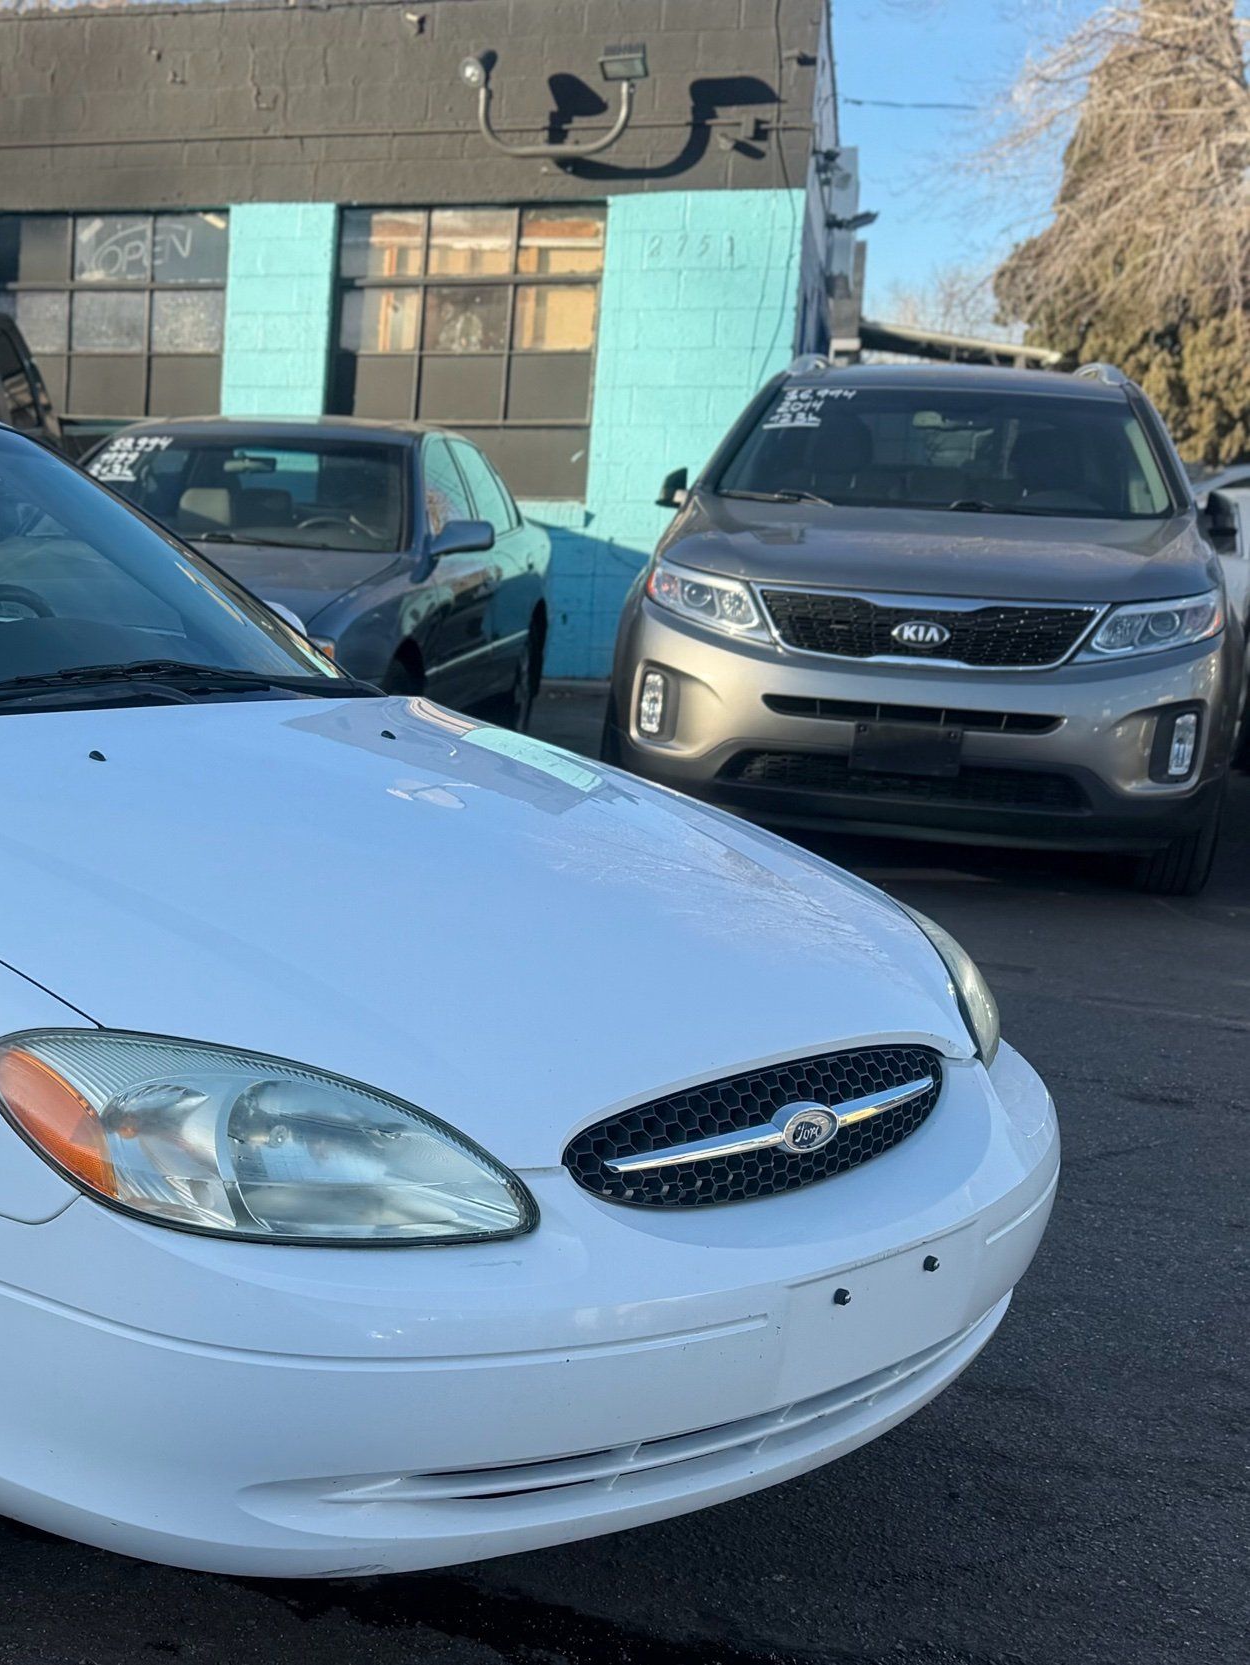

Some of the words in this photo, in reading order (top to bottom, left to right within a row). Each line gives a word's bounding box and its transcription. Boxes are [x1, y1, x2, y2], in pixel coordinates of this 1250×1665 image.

[98, 227, 192, 274] OPEN
[776, 400, 824, 413] 2014
[902, 625, 940, 642] KIA
